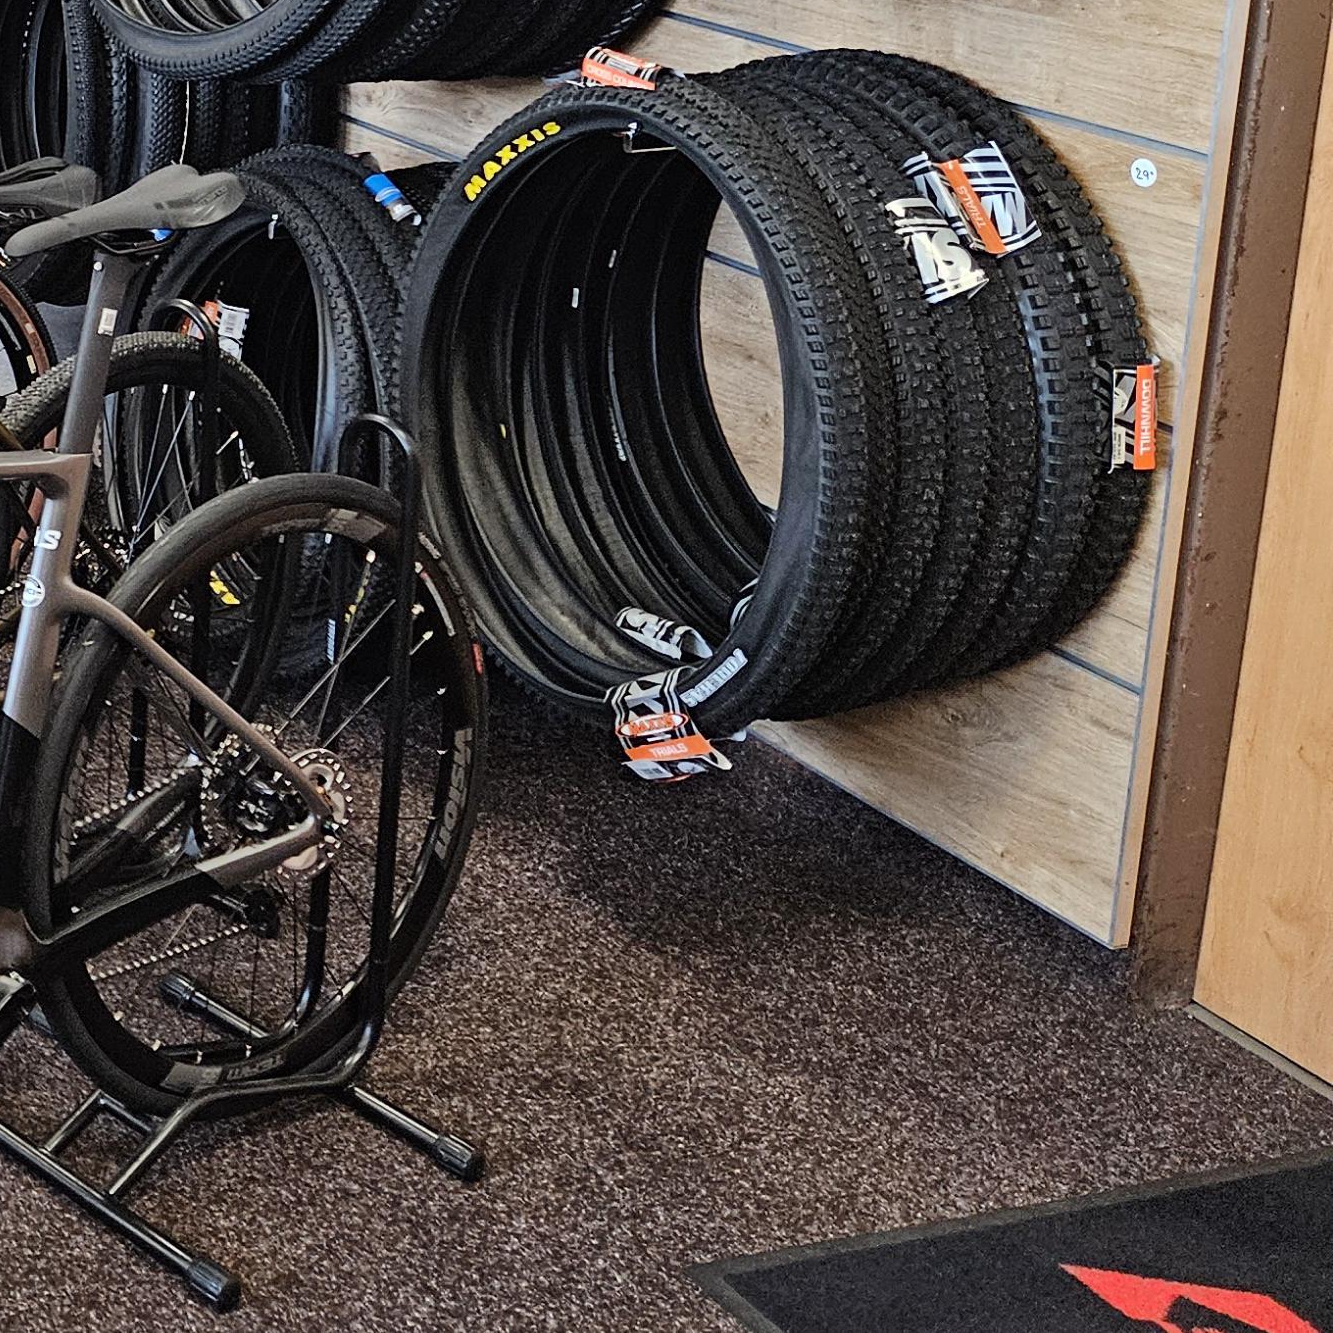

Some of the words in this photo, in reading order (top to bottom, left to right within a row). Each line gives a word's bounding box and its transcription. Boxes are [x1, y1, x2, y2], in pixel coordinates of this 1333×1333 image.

[463, 121, 562, 203] MAXXIS
[957, 184, 986, 228] TRIALS
[1139, 378, 1152, 455] DOWNHILL
[648, 743, 688, 758] TRIALS
